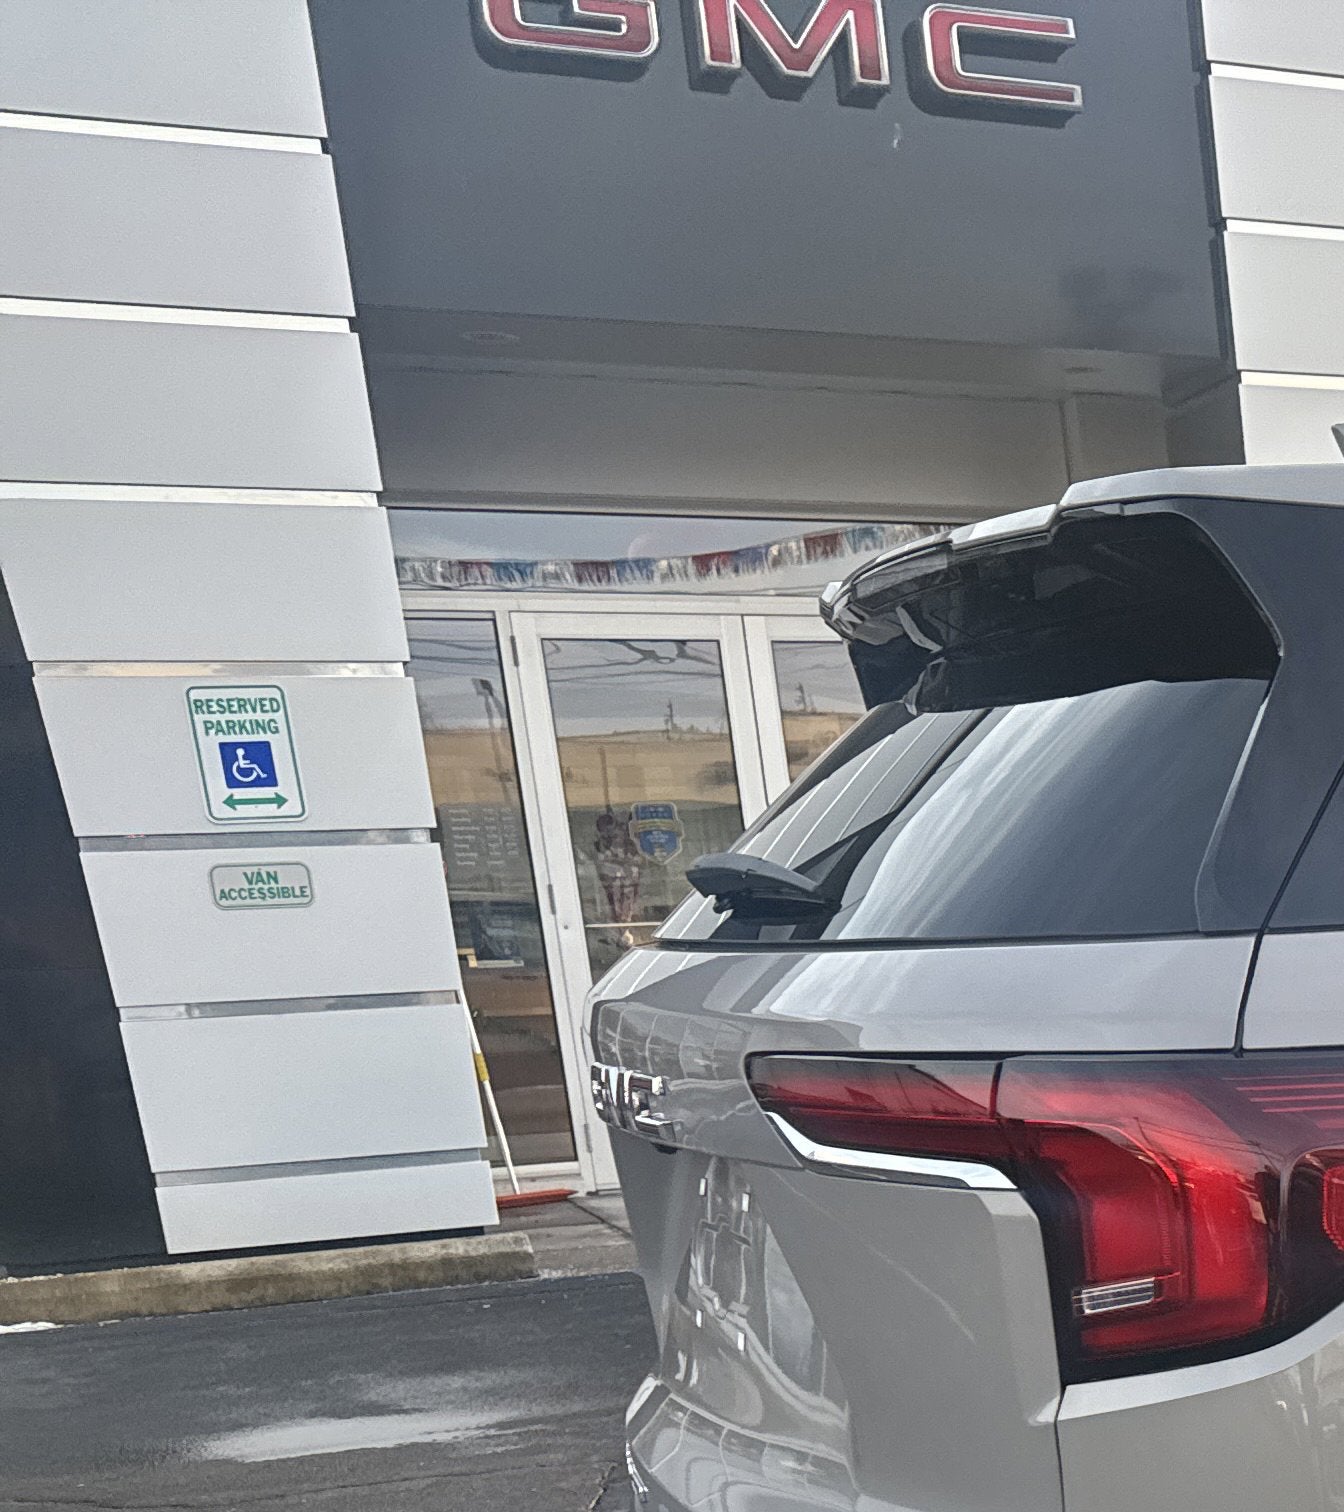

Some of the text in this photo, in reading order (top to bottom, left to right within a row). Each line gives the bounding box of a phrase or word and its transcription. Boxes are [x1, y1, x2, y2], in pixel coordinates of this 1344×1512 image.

[193, 697, 281, 716] RESERVED
[203, 719, 280, 737] PARKING
[243, 870, 279, 886] VAN
[219, 885, 309, 901] ACCESSIBLE
